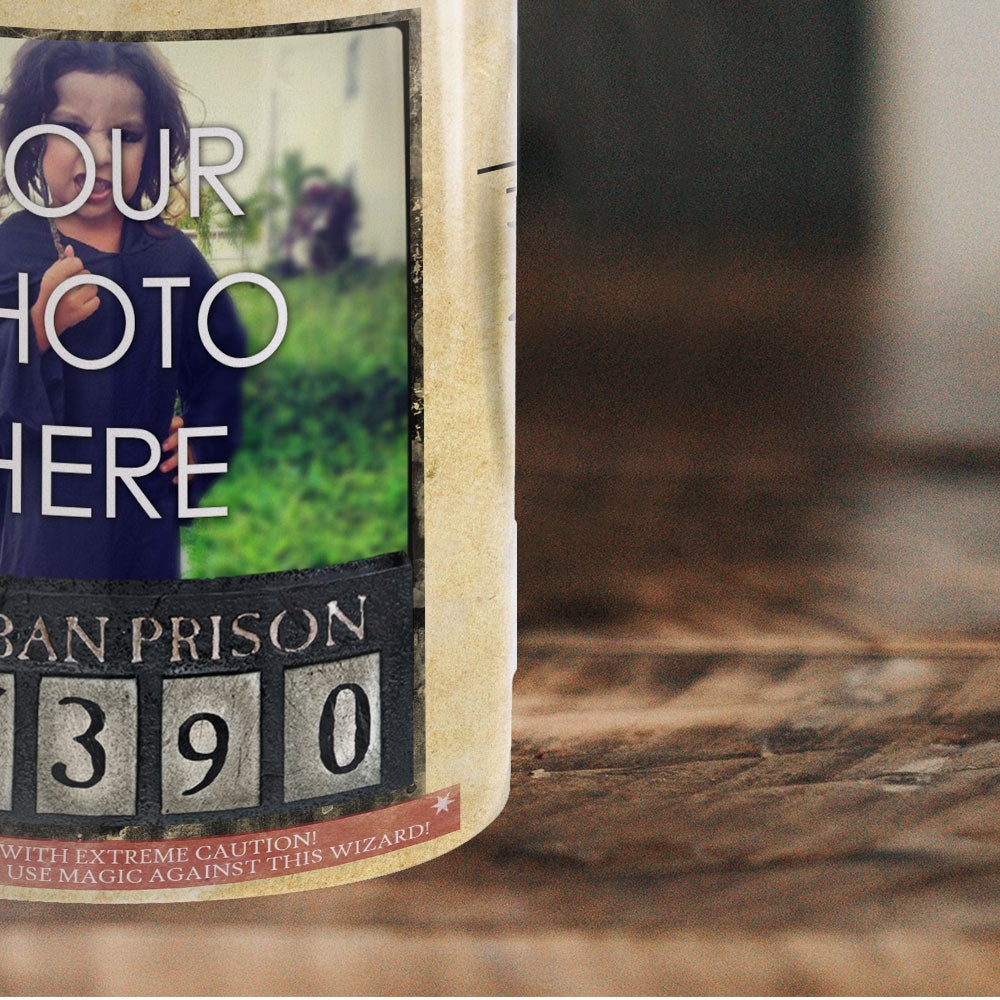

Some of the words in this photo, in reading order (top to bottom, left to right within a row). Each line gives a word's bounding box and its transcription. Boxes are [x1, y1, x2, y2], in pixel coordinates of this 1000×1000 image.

[131, 595, 367, 664] PRISON
[0, 844, 68, 864] WITH
[75, 847, 189, 865] EXTREME
[195, 830, 318, 861] CAUTION!
[7, 865, 52, 882] USE
[58, 868, 143, 884] MAGIC
[148, 859, 257, 883] AGAINST
[265, 849, 323, 872] THIS
[329, 821, 431, 859] WIZARD!
